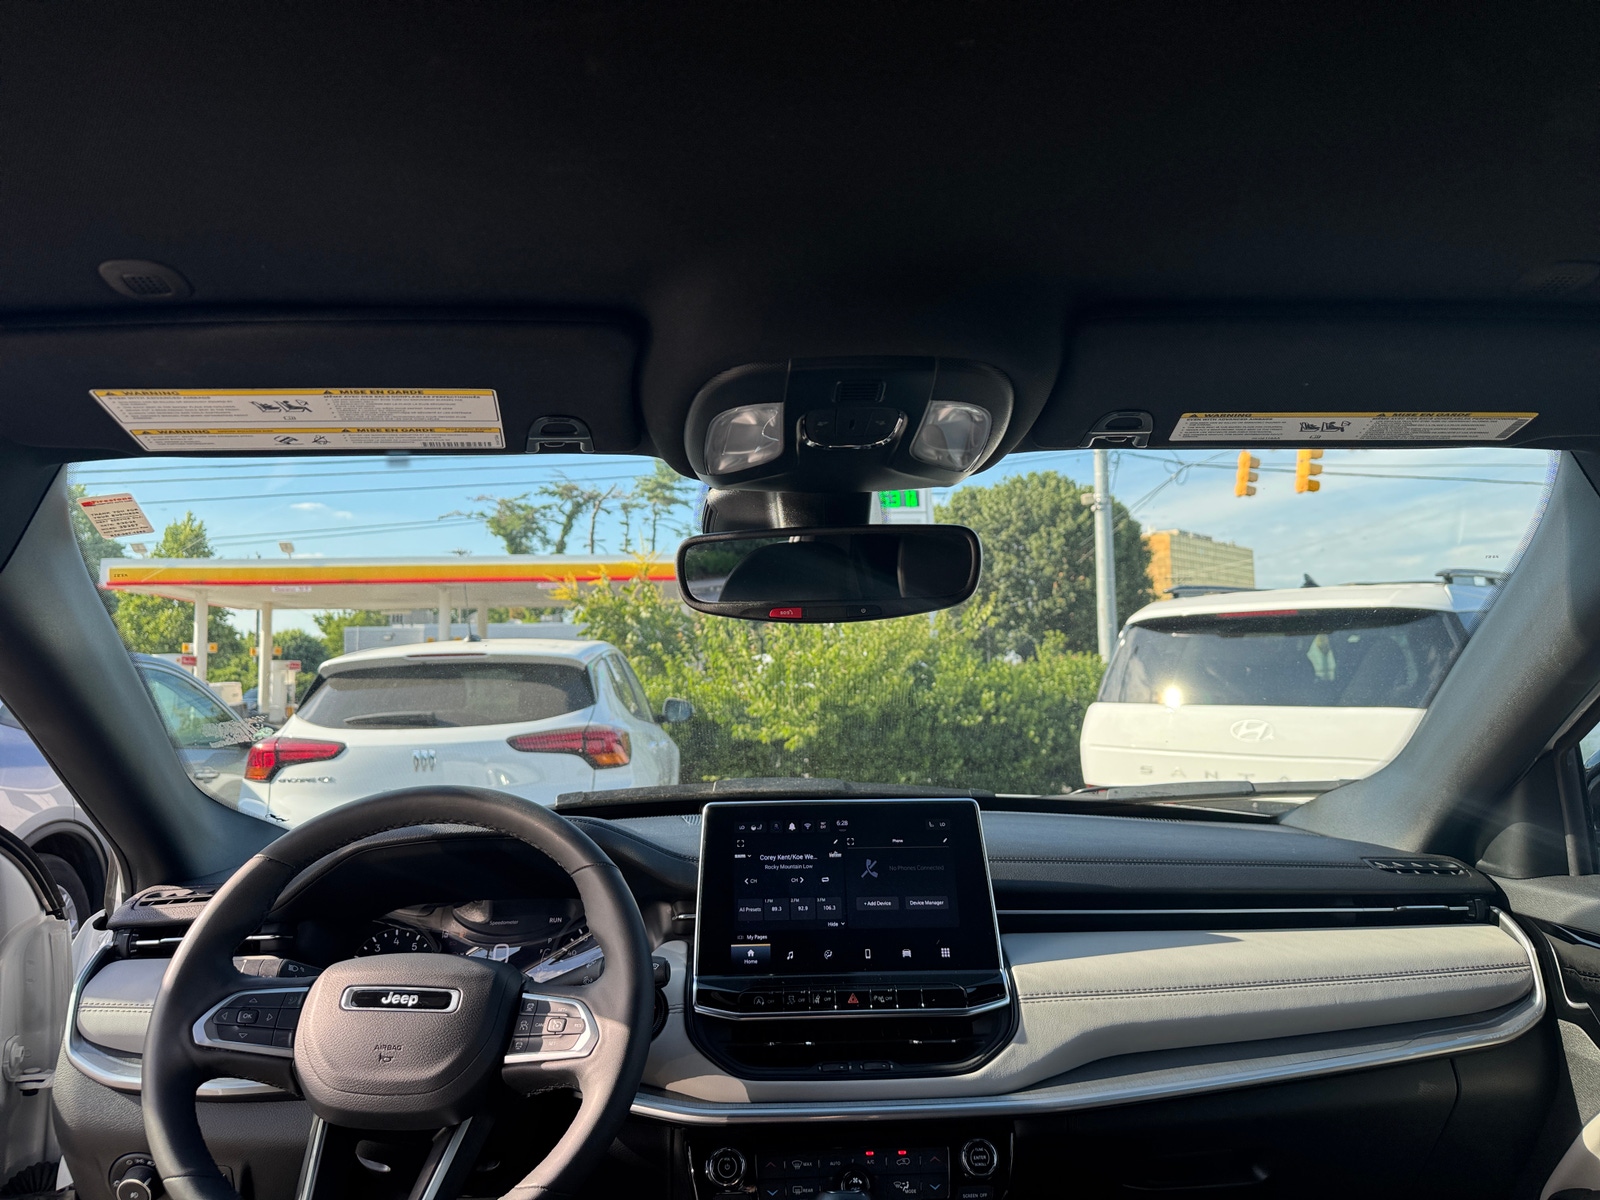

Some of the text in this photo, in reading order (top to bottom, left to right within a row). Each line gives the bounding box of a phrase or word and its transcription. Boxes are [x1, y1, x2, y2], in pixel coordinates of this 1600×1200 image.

[393, 937, 400, 945] 4
[375, 944, 380, 952] 3
[411, 942, 417, 951] 5
[381, 992, 418, 1007] Jeep
